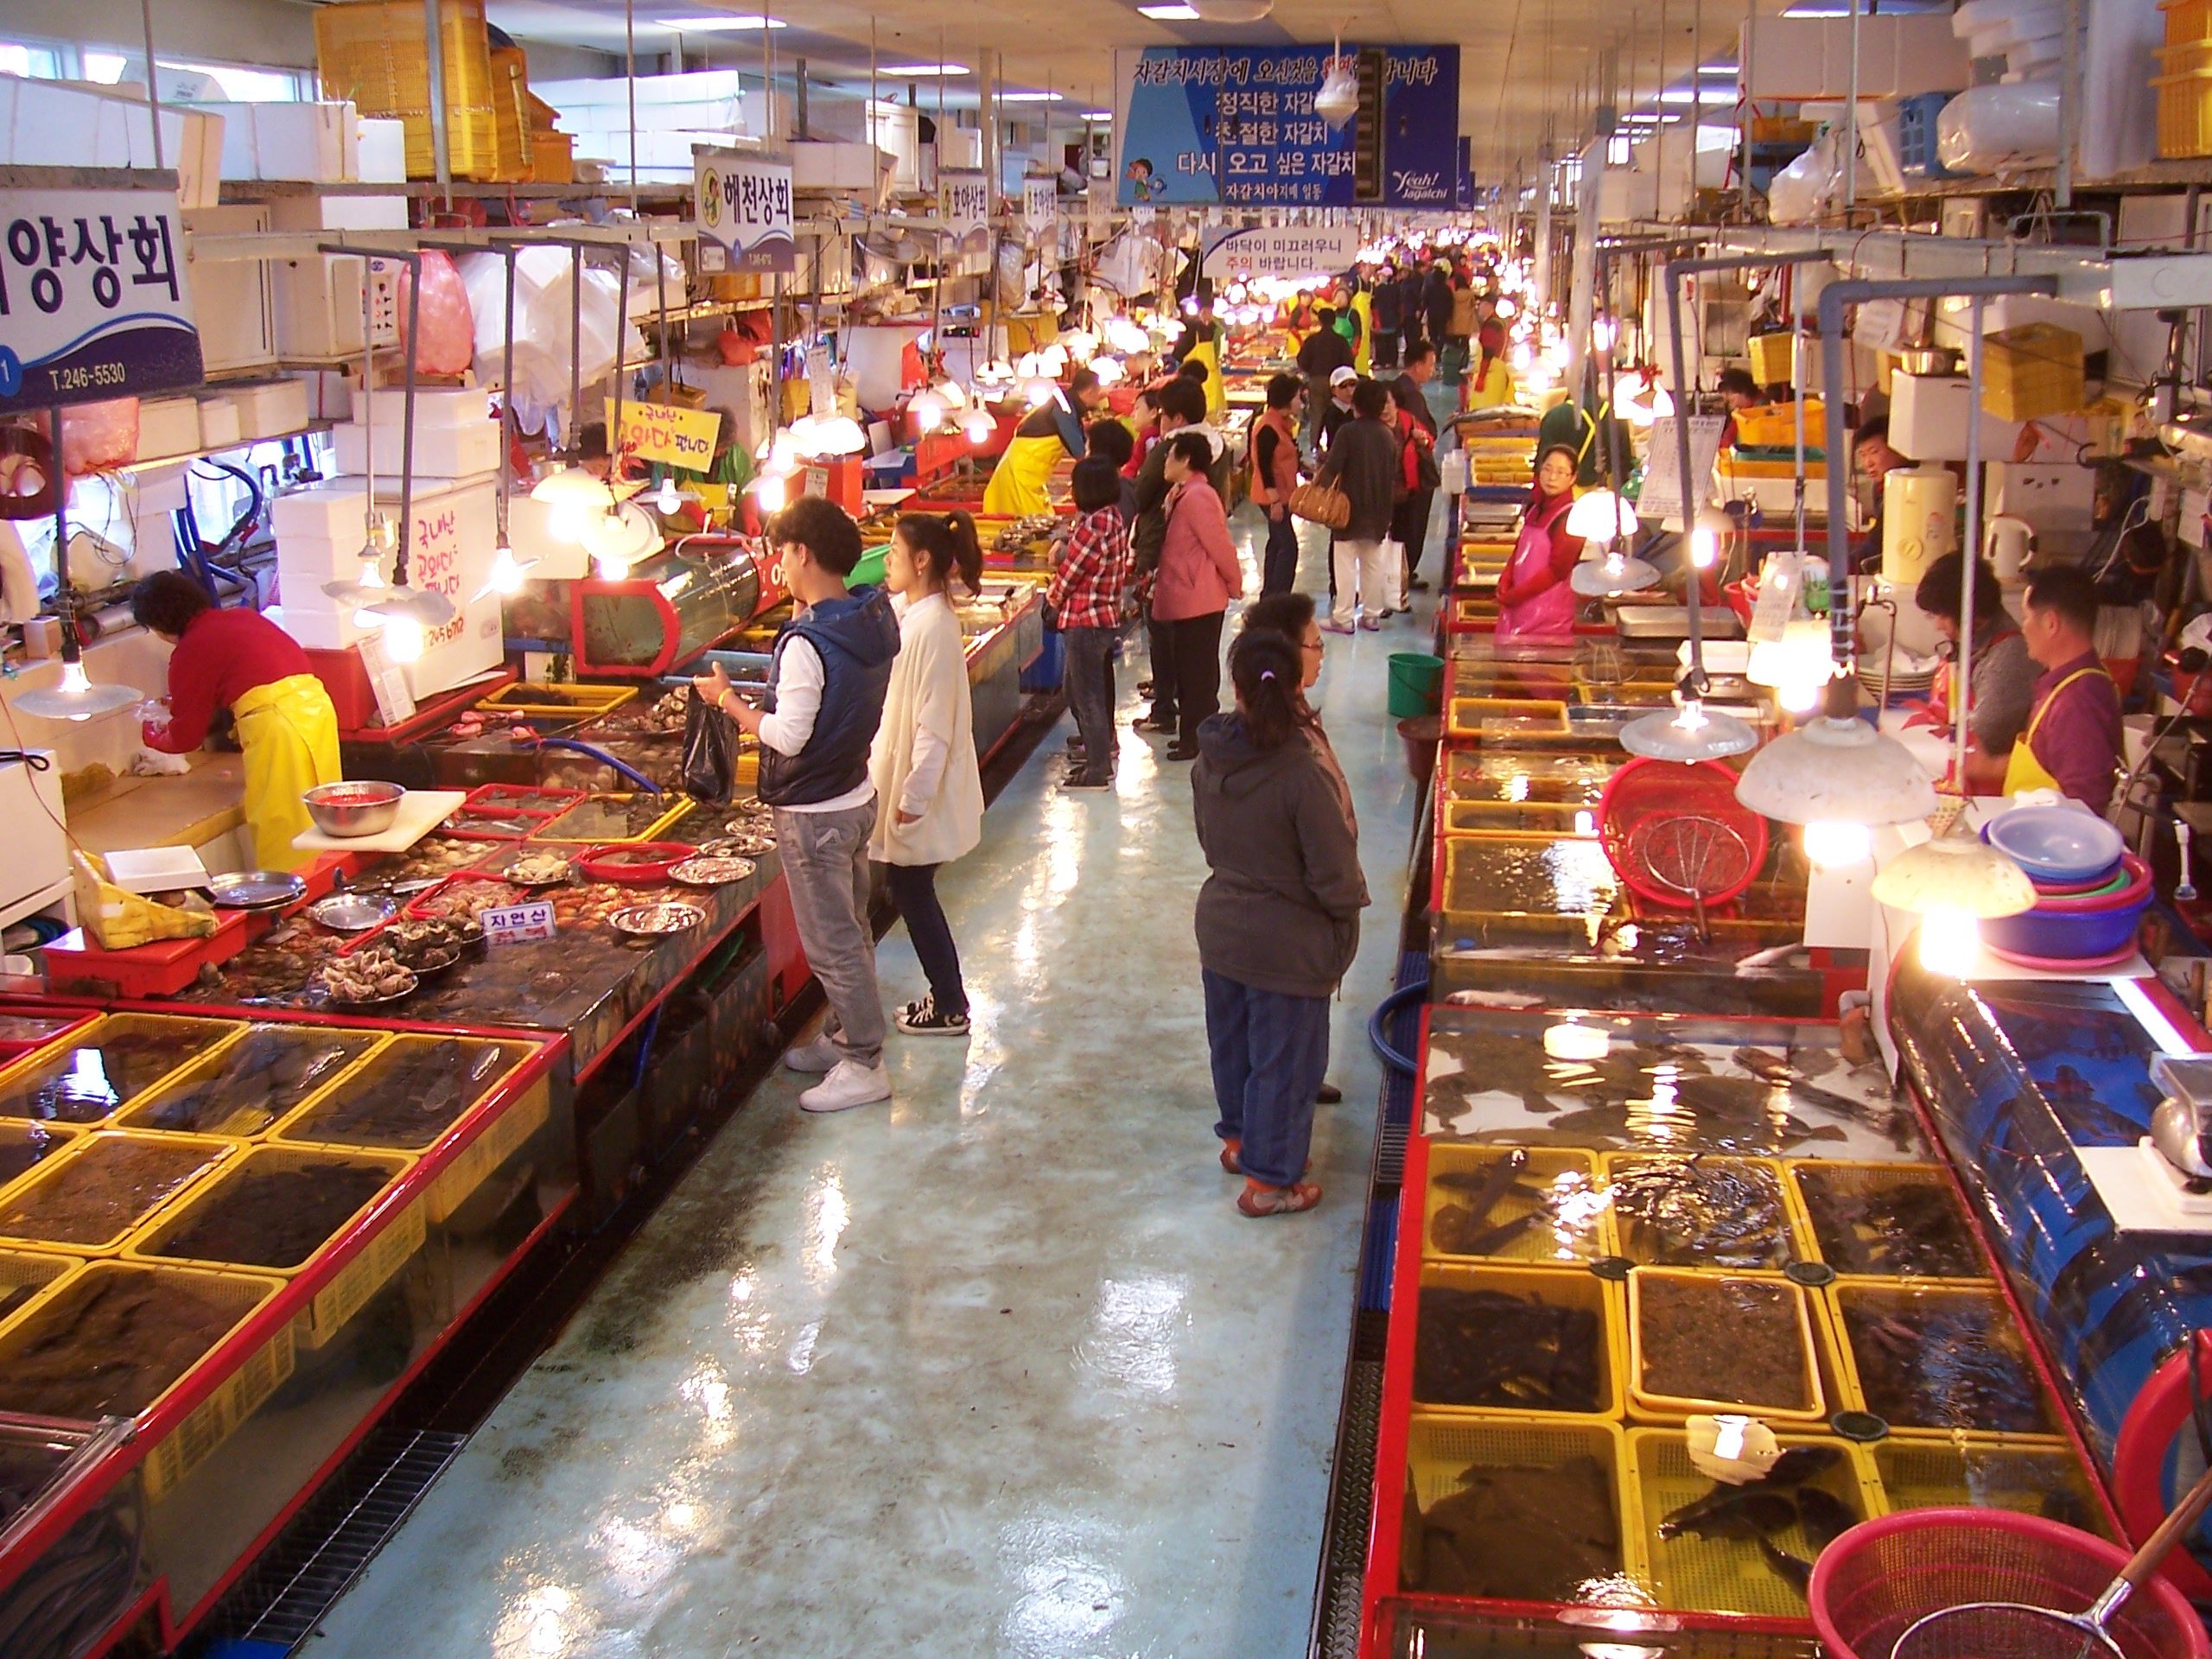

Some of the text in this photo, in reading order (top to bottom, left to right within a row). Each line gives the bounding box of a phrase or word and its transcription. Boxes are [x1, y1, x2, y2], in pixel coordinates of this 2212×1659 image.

[1133, 57, 1251, 86] 자갈치시장에
[1215, 91, 1314, 116] 정직한 자갈
[1284, 121, 1328, 145] 자갈치
[1177, 151, 1356, 176] 다시 오고 싶은 자갈치
[1393, 170, 1440, 193] Yeah!
[723, 174, 790, 226] 해천상회
[1402, 188, 1449, 201] Jagalchi
[1225, 238, 1267, 253] 바닥이
[0, 215, 180, 315] 양상회
[1225, 257, 1253, 270] 주의
[1259, 257, 1319, 270] 바랍니다.
[49, 362, 126, 391] T.246-5530
[645, 405, 677, 423] 국내산
[418, 510, 455, 550] 국내산
[491, 909, 546, 927] 자연산
